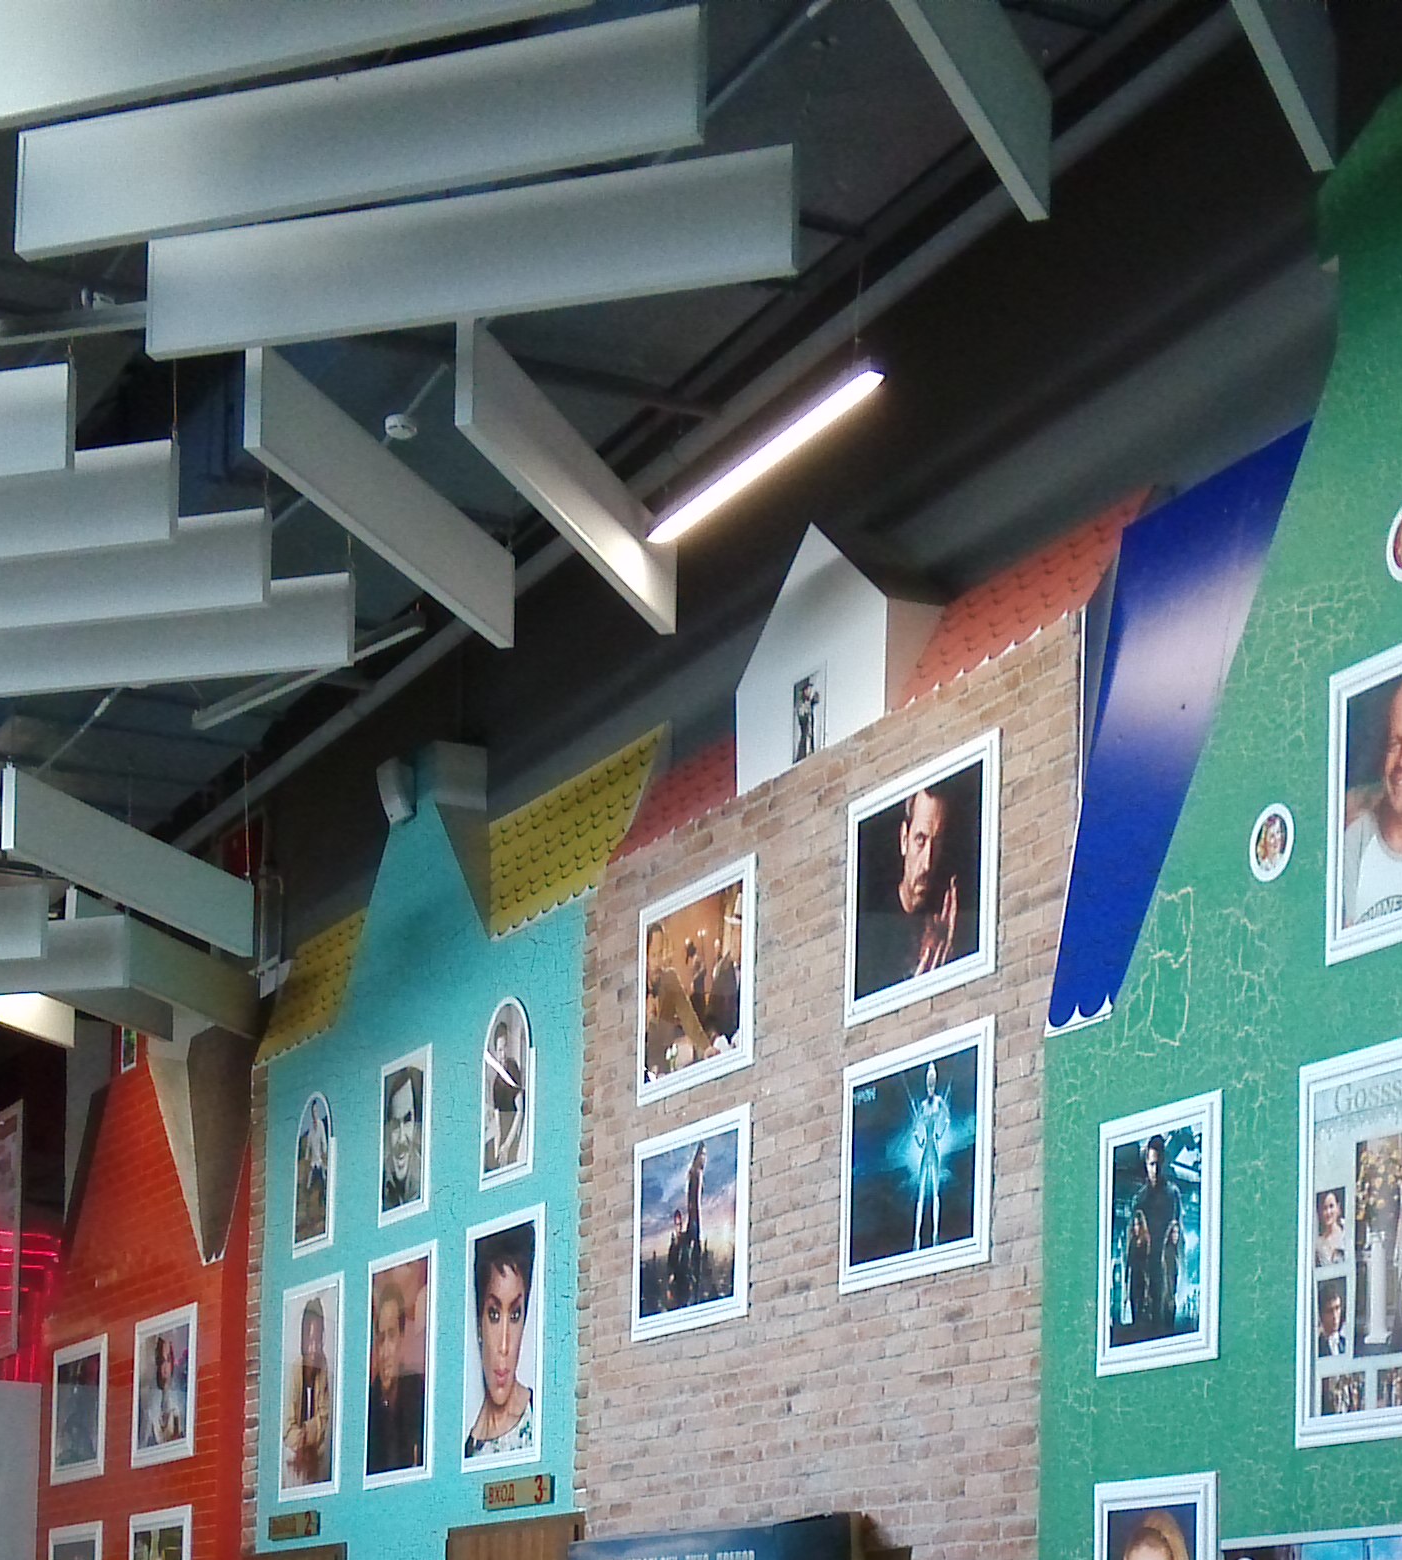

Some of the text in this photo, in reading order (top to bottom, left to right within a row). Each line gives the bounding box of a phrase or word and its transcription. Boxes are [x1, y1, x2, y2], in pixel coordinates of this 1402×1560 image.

[488, 1475, 543, 1505] ВХОД 3
[304, 1511, 312, 1536] 2
